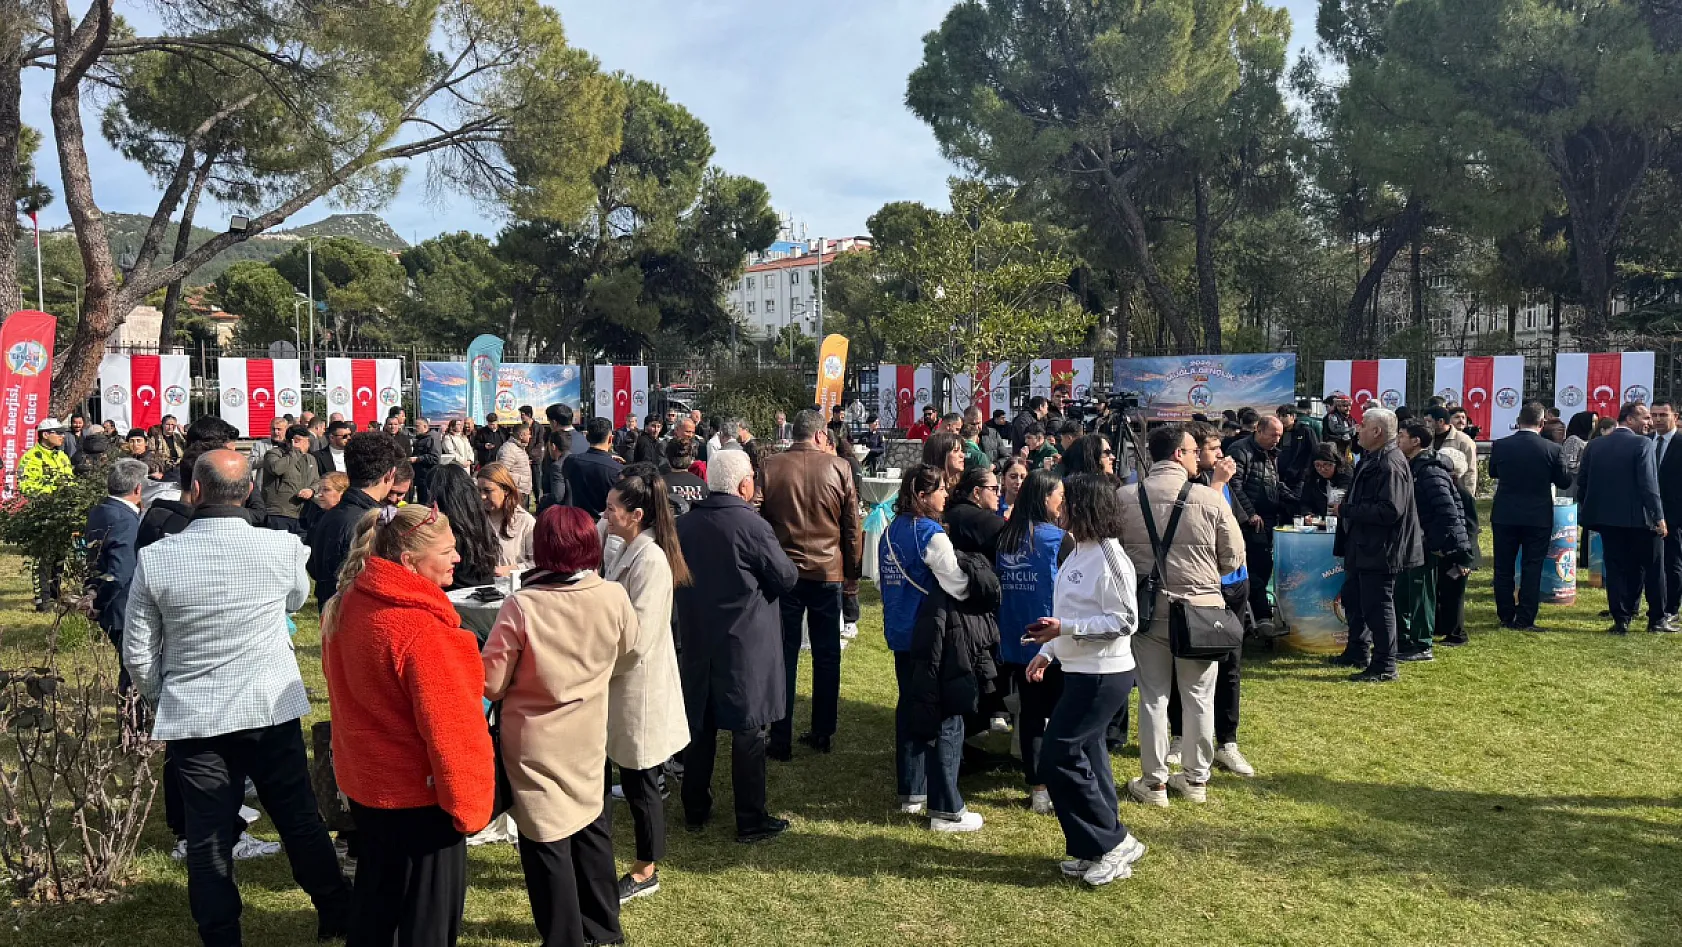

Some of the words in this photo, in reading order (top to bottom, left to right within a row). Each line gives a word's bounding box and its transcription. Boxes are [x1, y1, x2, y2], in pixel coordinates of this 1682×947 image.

[3, 383, 22, 436] Enerjisi,
[23, 393, 38, 425] Gücü
[1001, 570, 1038, 582] ENÇLİK
[1321, 563, 1344, 578] MUĞL
